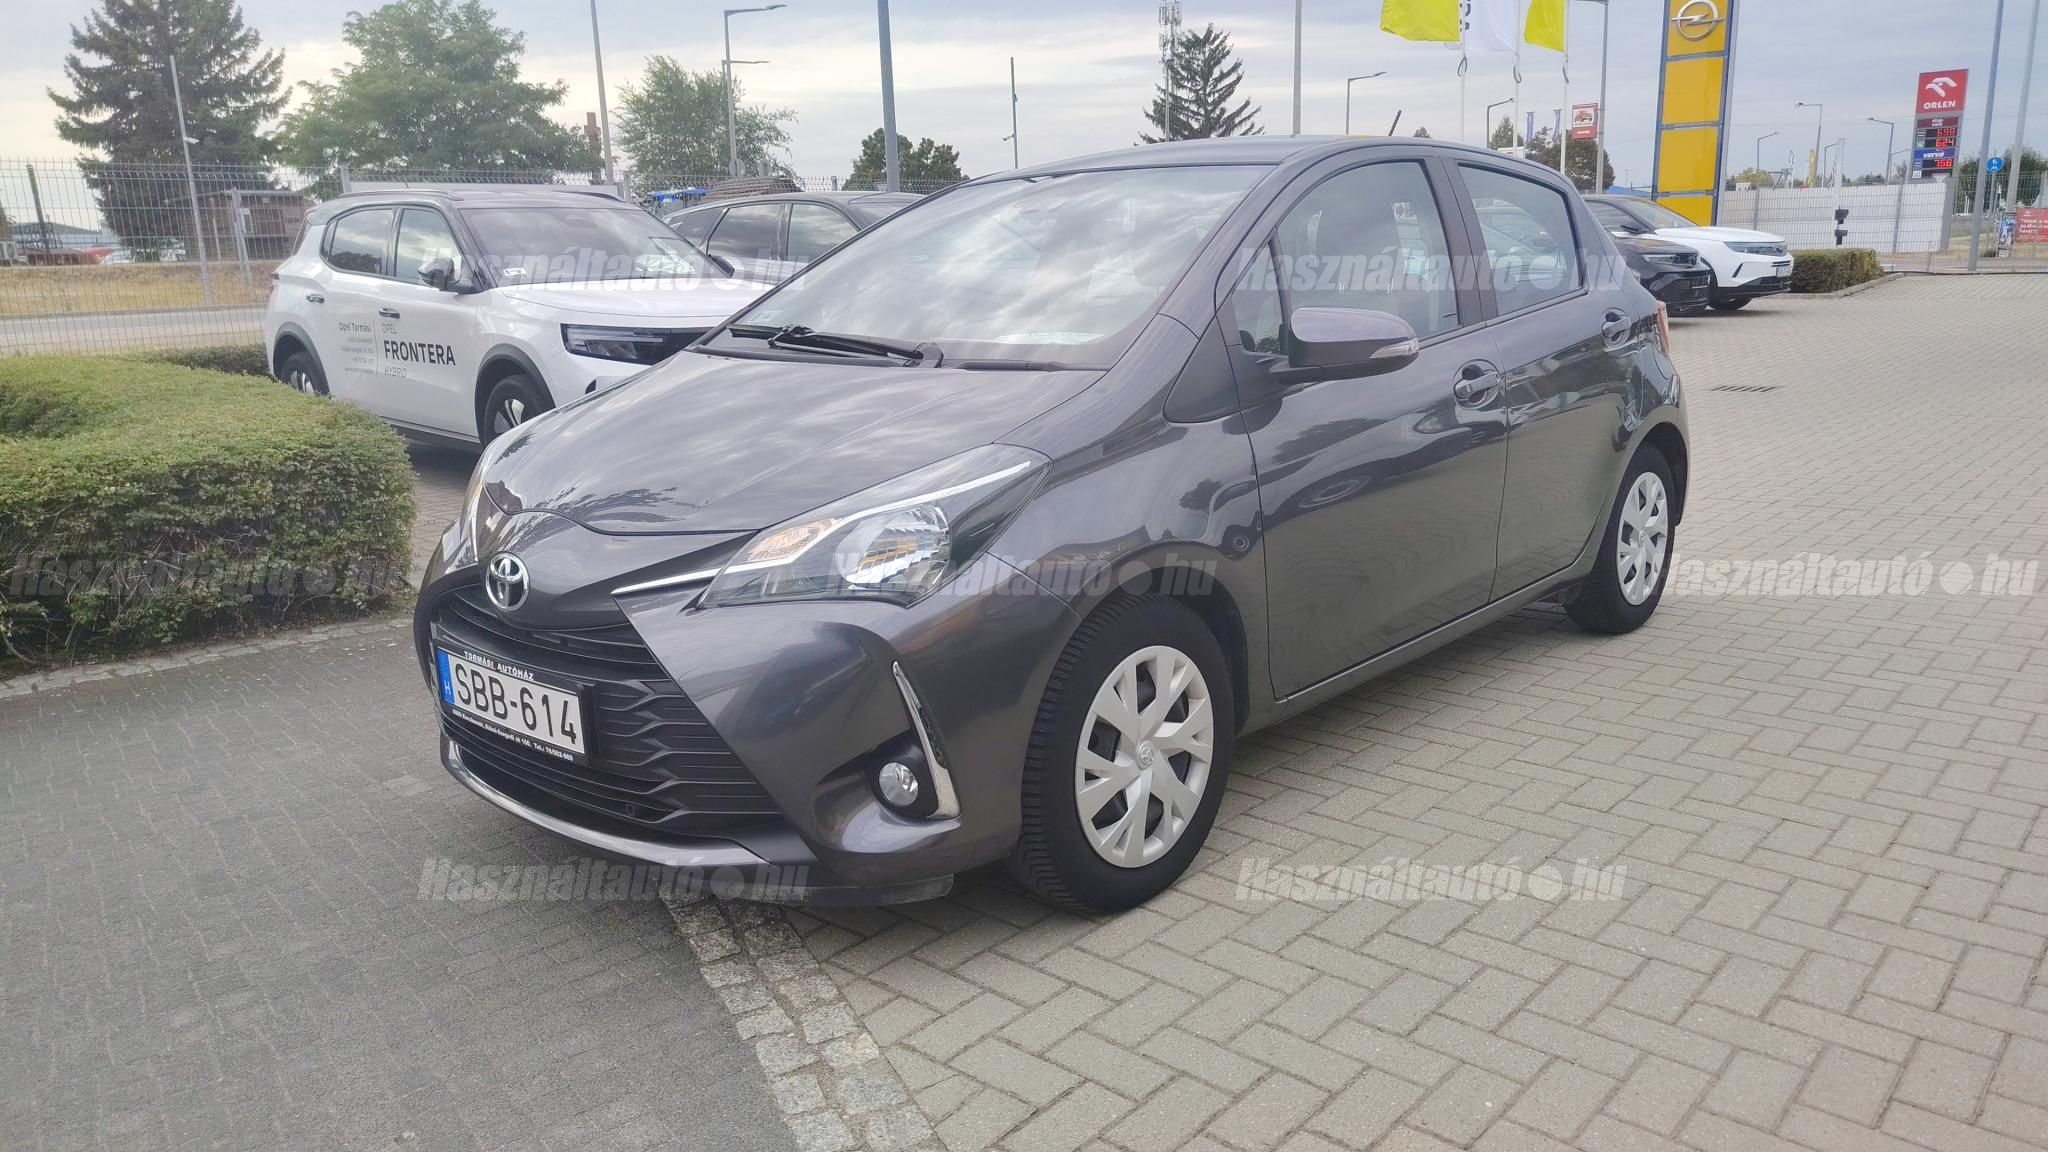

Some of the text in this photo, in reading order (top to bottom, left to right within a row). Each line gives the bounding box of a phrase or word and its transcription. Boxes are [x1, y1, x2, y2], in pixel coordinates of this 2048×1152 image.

[1923, 100, 1956, 110] ORLEN
[1935, 137, 1955, 148] 624
[1934, 158, 1953, 168] 758
[339, 321, 351, 333] Opel
[381, 323, 398, 334] OPEL
[383, 340, 457, 366] FRONTERA
[384, 367, 408, 378] HYBRID
[463, 650, 534, 681] TORMÁSI AUTÓHÁZ
[444, 680, 452, 696] H
[455, 663, 577, 745] SBB-614
